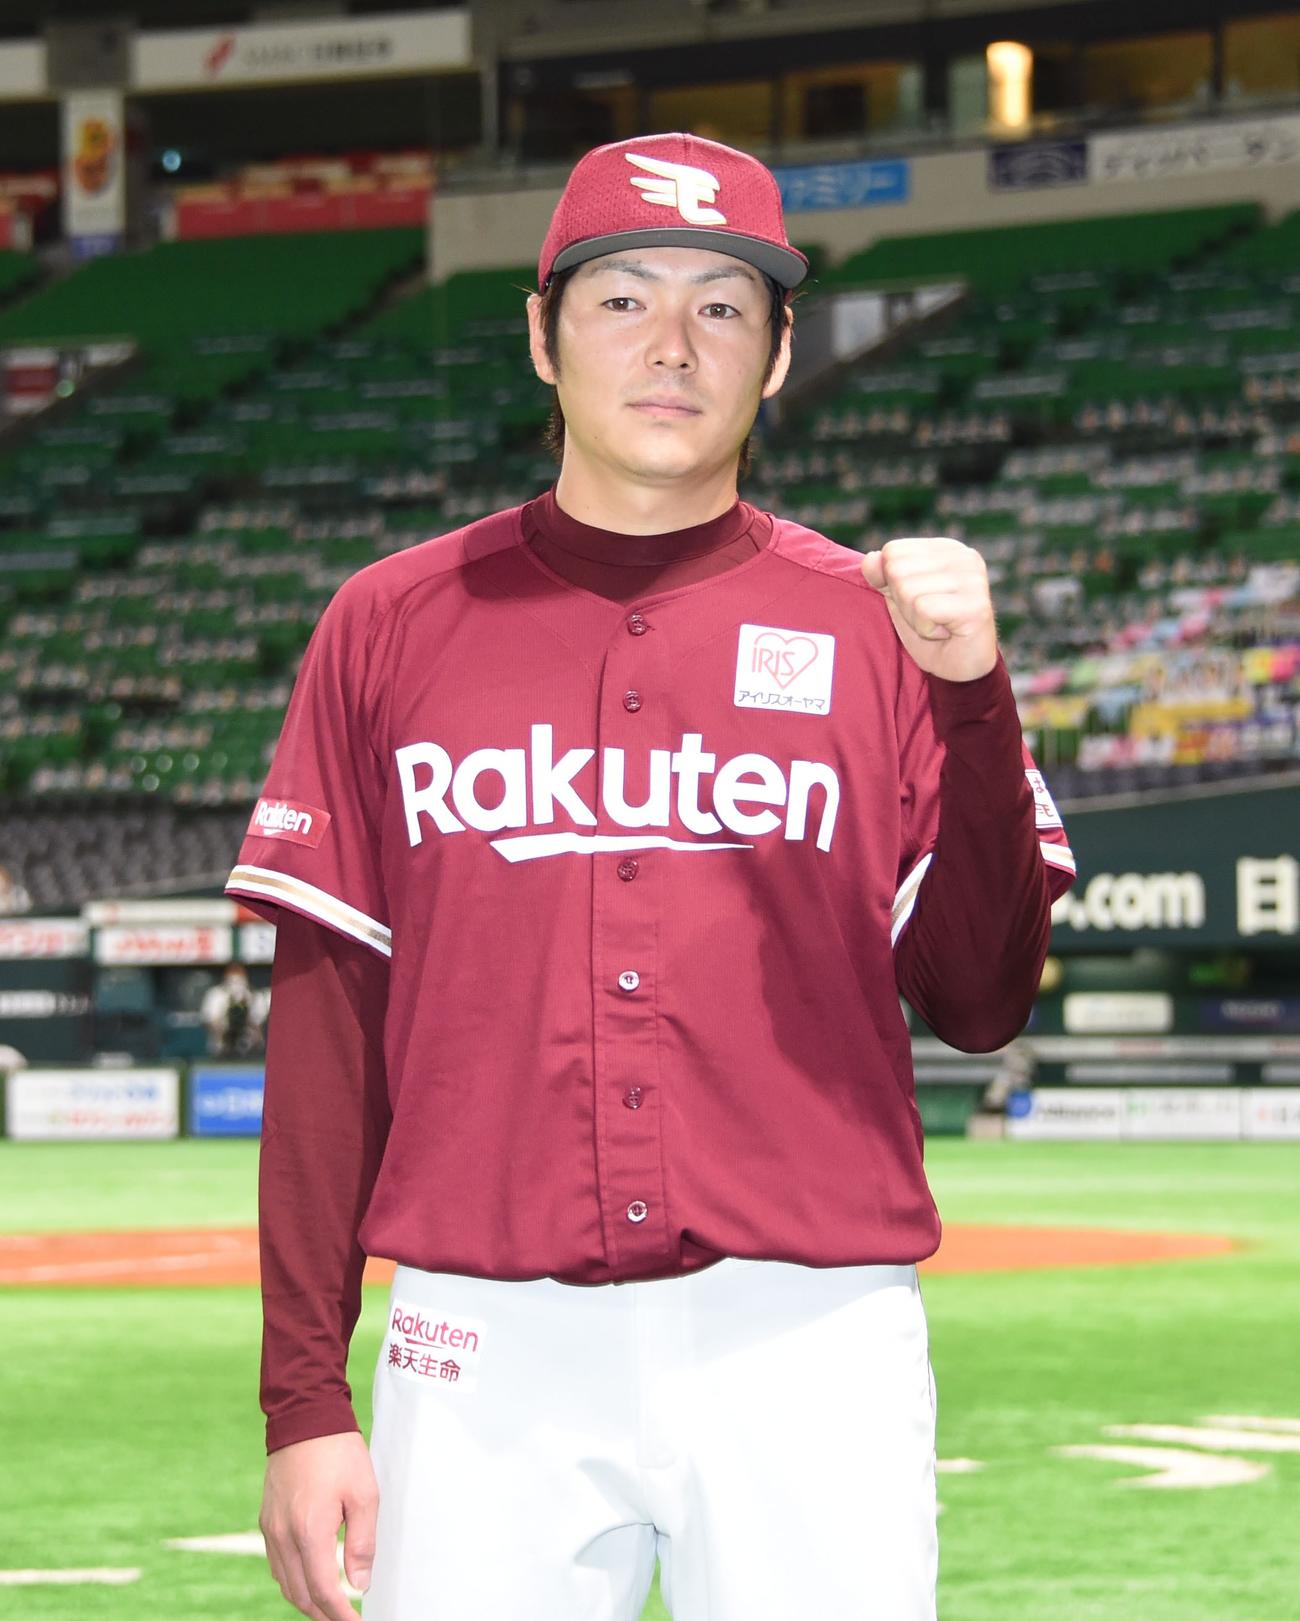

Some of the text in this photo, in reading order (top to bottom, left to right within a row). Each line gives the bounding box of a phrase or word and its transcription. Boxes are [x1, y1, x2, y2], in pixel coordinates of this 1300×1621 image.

[751, 647, 796, 677] IRIS
[738, 690, 826, 710] アイリスオーヤマ
[395, 723, 840, 853] Rakuten
[255, 801, 312, 834] Rakten
[392, 1307, 479, 1352] Rakuten
[388, 1343, 461, 1382] 楽天生命
